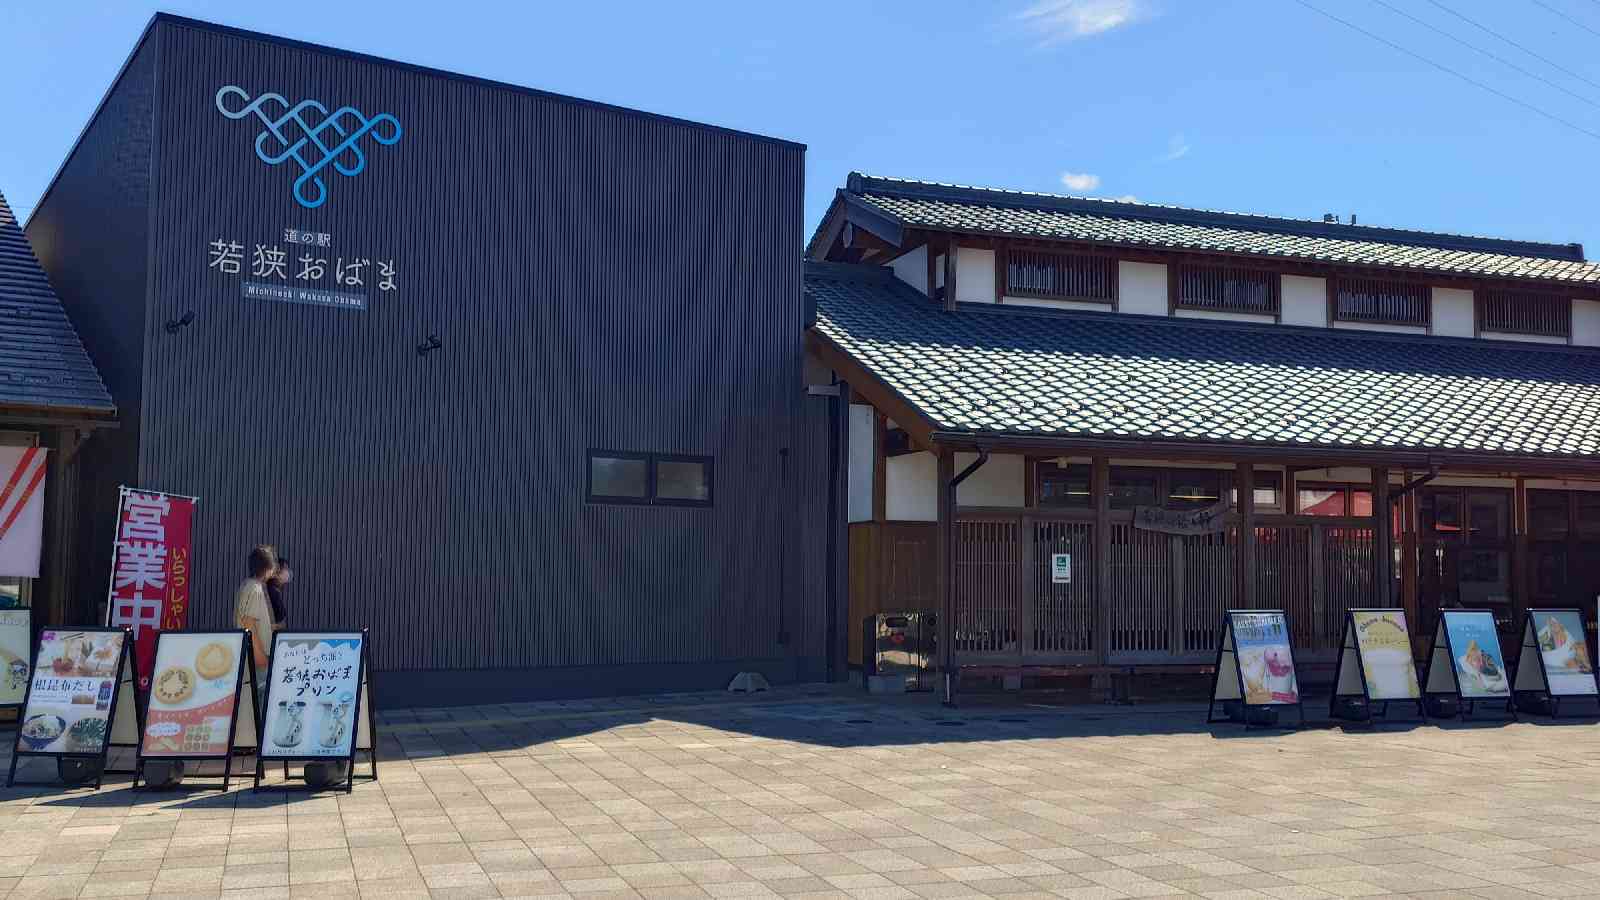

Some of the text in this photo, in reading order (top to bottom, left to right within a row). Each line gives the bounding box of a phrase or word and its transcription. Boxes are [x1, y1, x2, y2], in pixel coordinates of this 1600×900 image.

[284, 229, 331, 248] 道の駅
[209, 239, 397, 291] 若狭おばま
[112, 492, 170, 640] 営業中
[296, 682, 337, 697] プリン
